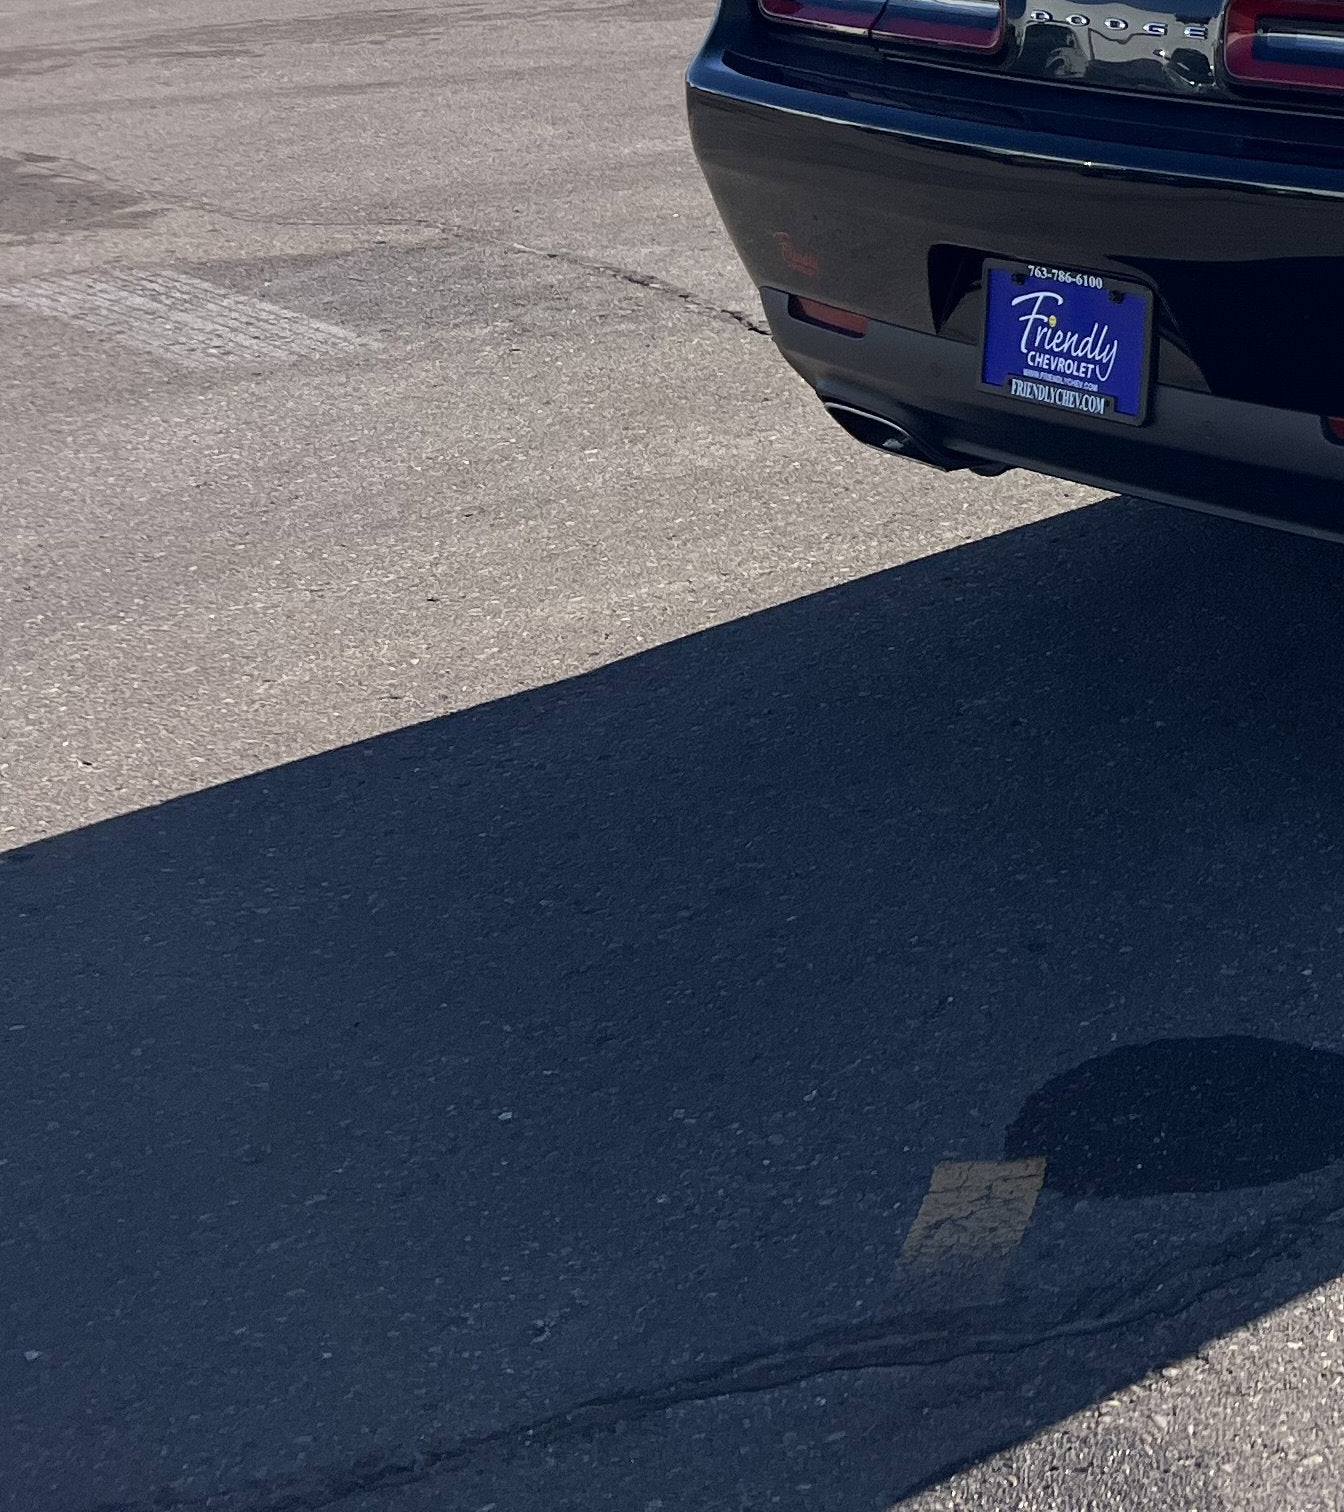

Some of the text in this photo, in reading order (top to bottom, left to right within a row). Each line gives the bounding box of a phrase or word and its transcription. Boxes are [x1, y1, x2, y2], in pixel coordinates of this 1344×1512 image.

[1031, 10, 1208, 40] DODGE
[1028, 265, 1103, 289] 763-786-6100
[1011, 291, 1118, 381] Friendly
[1027, 351, 1095, 378] CHEVROLET
[1011, 378, 1105, 415] FRIENDLYCHEV.COM
